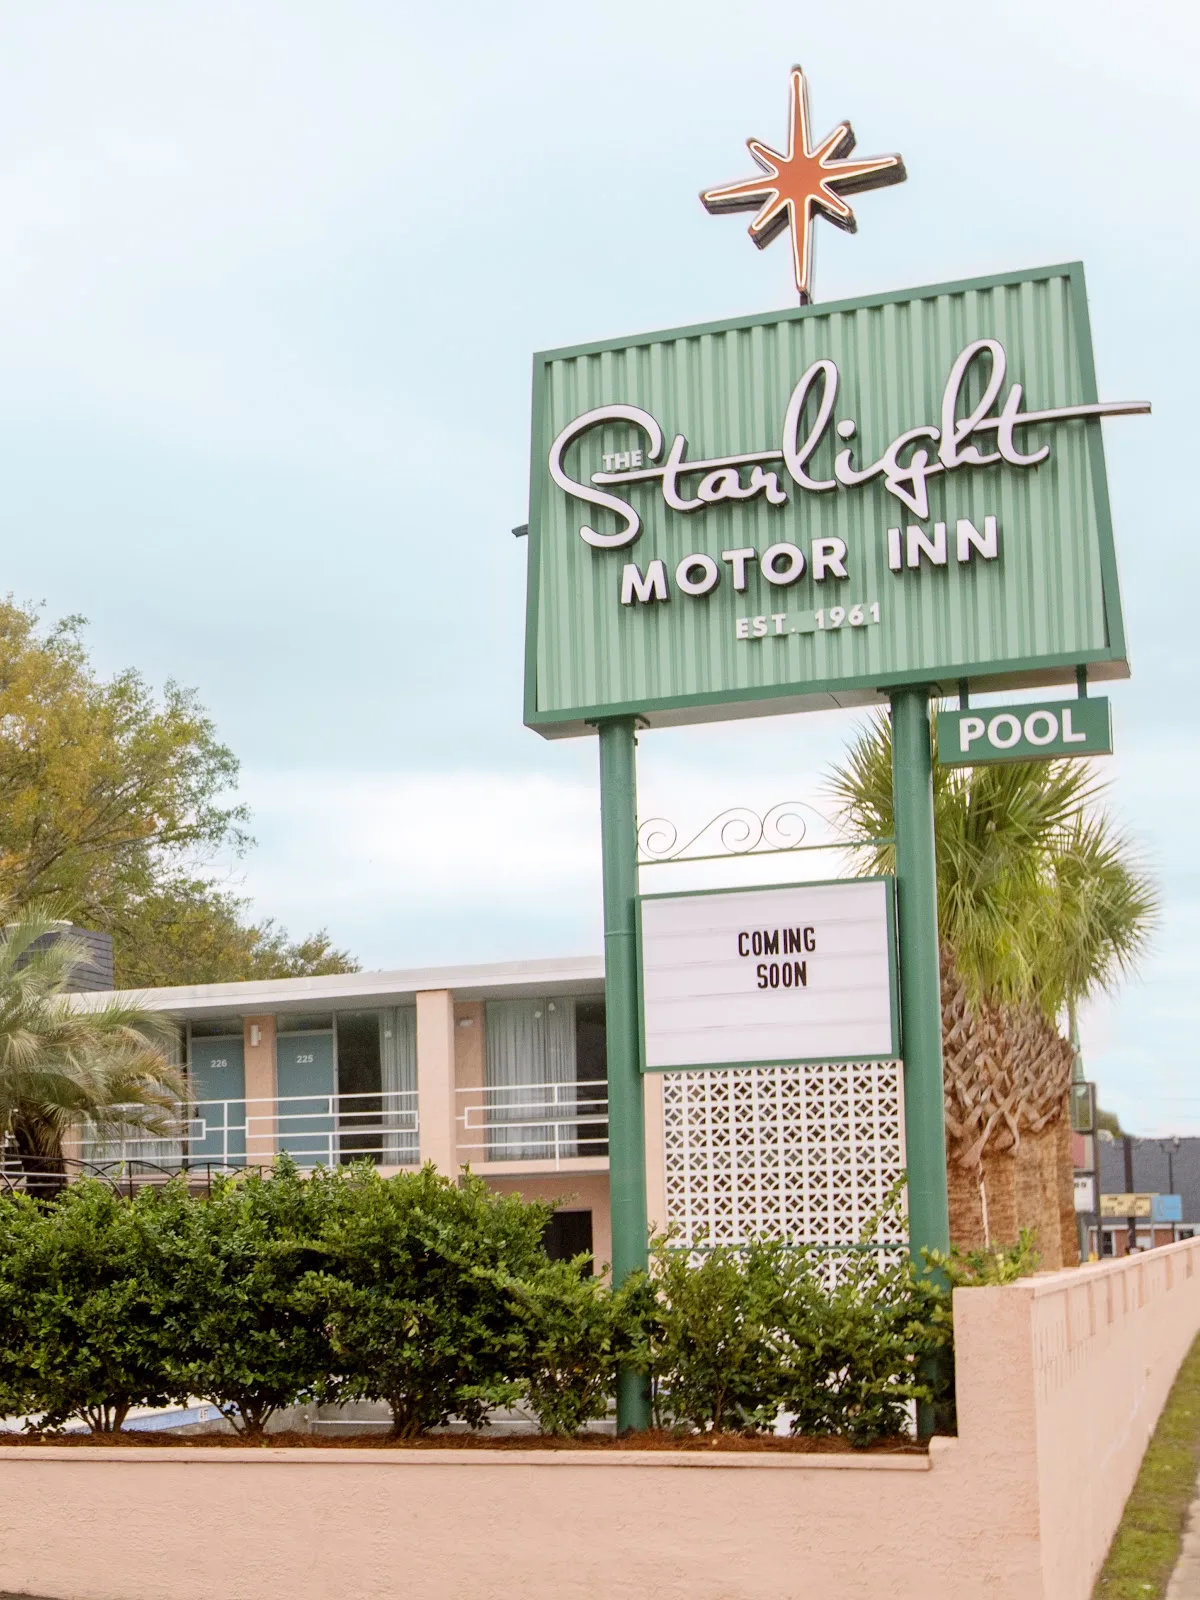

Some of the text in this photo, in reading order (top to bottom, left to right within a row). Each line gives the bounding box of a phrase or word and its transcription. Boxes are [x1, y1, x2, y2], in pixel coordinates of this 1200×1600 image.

[548, 338, 1152, 549] Starlight
[602, 449, 644, 471] THE
[621, 515, 998, 607] MOTOR INN
[736, 602, 880, 639] EST. 1961
[959, 708, 1087, 752] POOL
[738, 926, 816, 957] COMING
[756, 960, 808, 989] SOON
[210, 1059, 228, 1069] 226
[296, 1054, 314, 1064] 225
